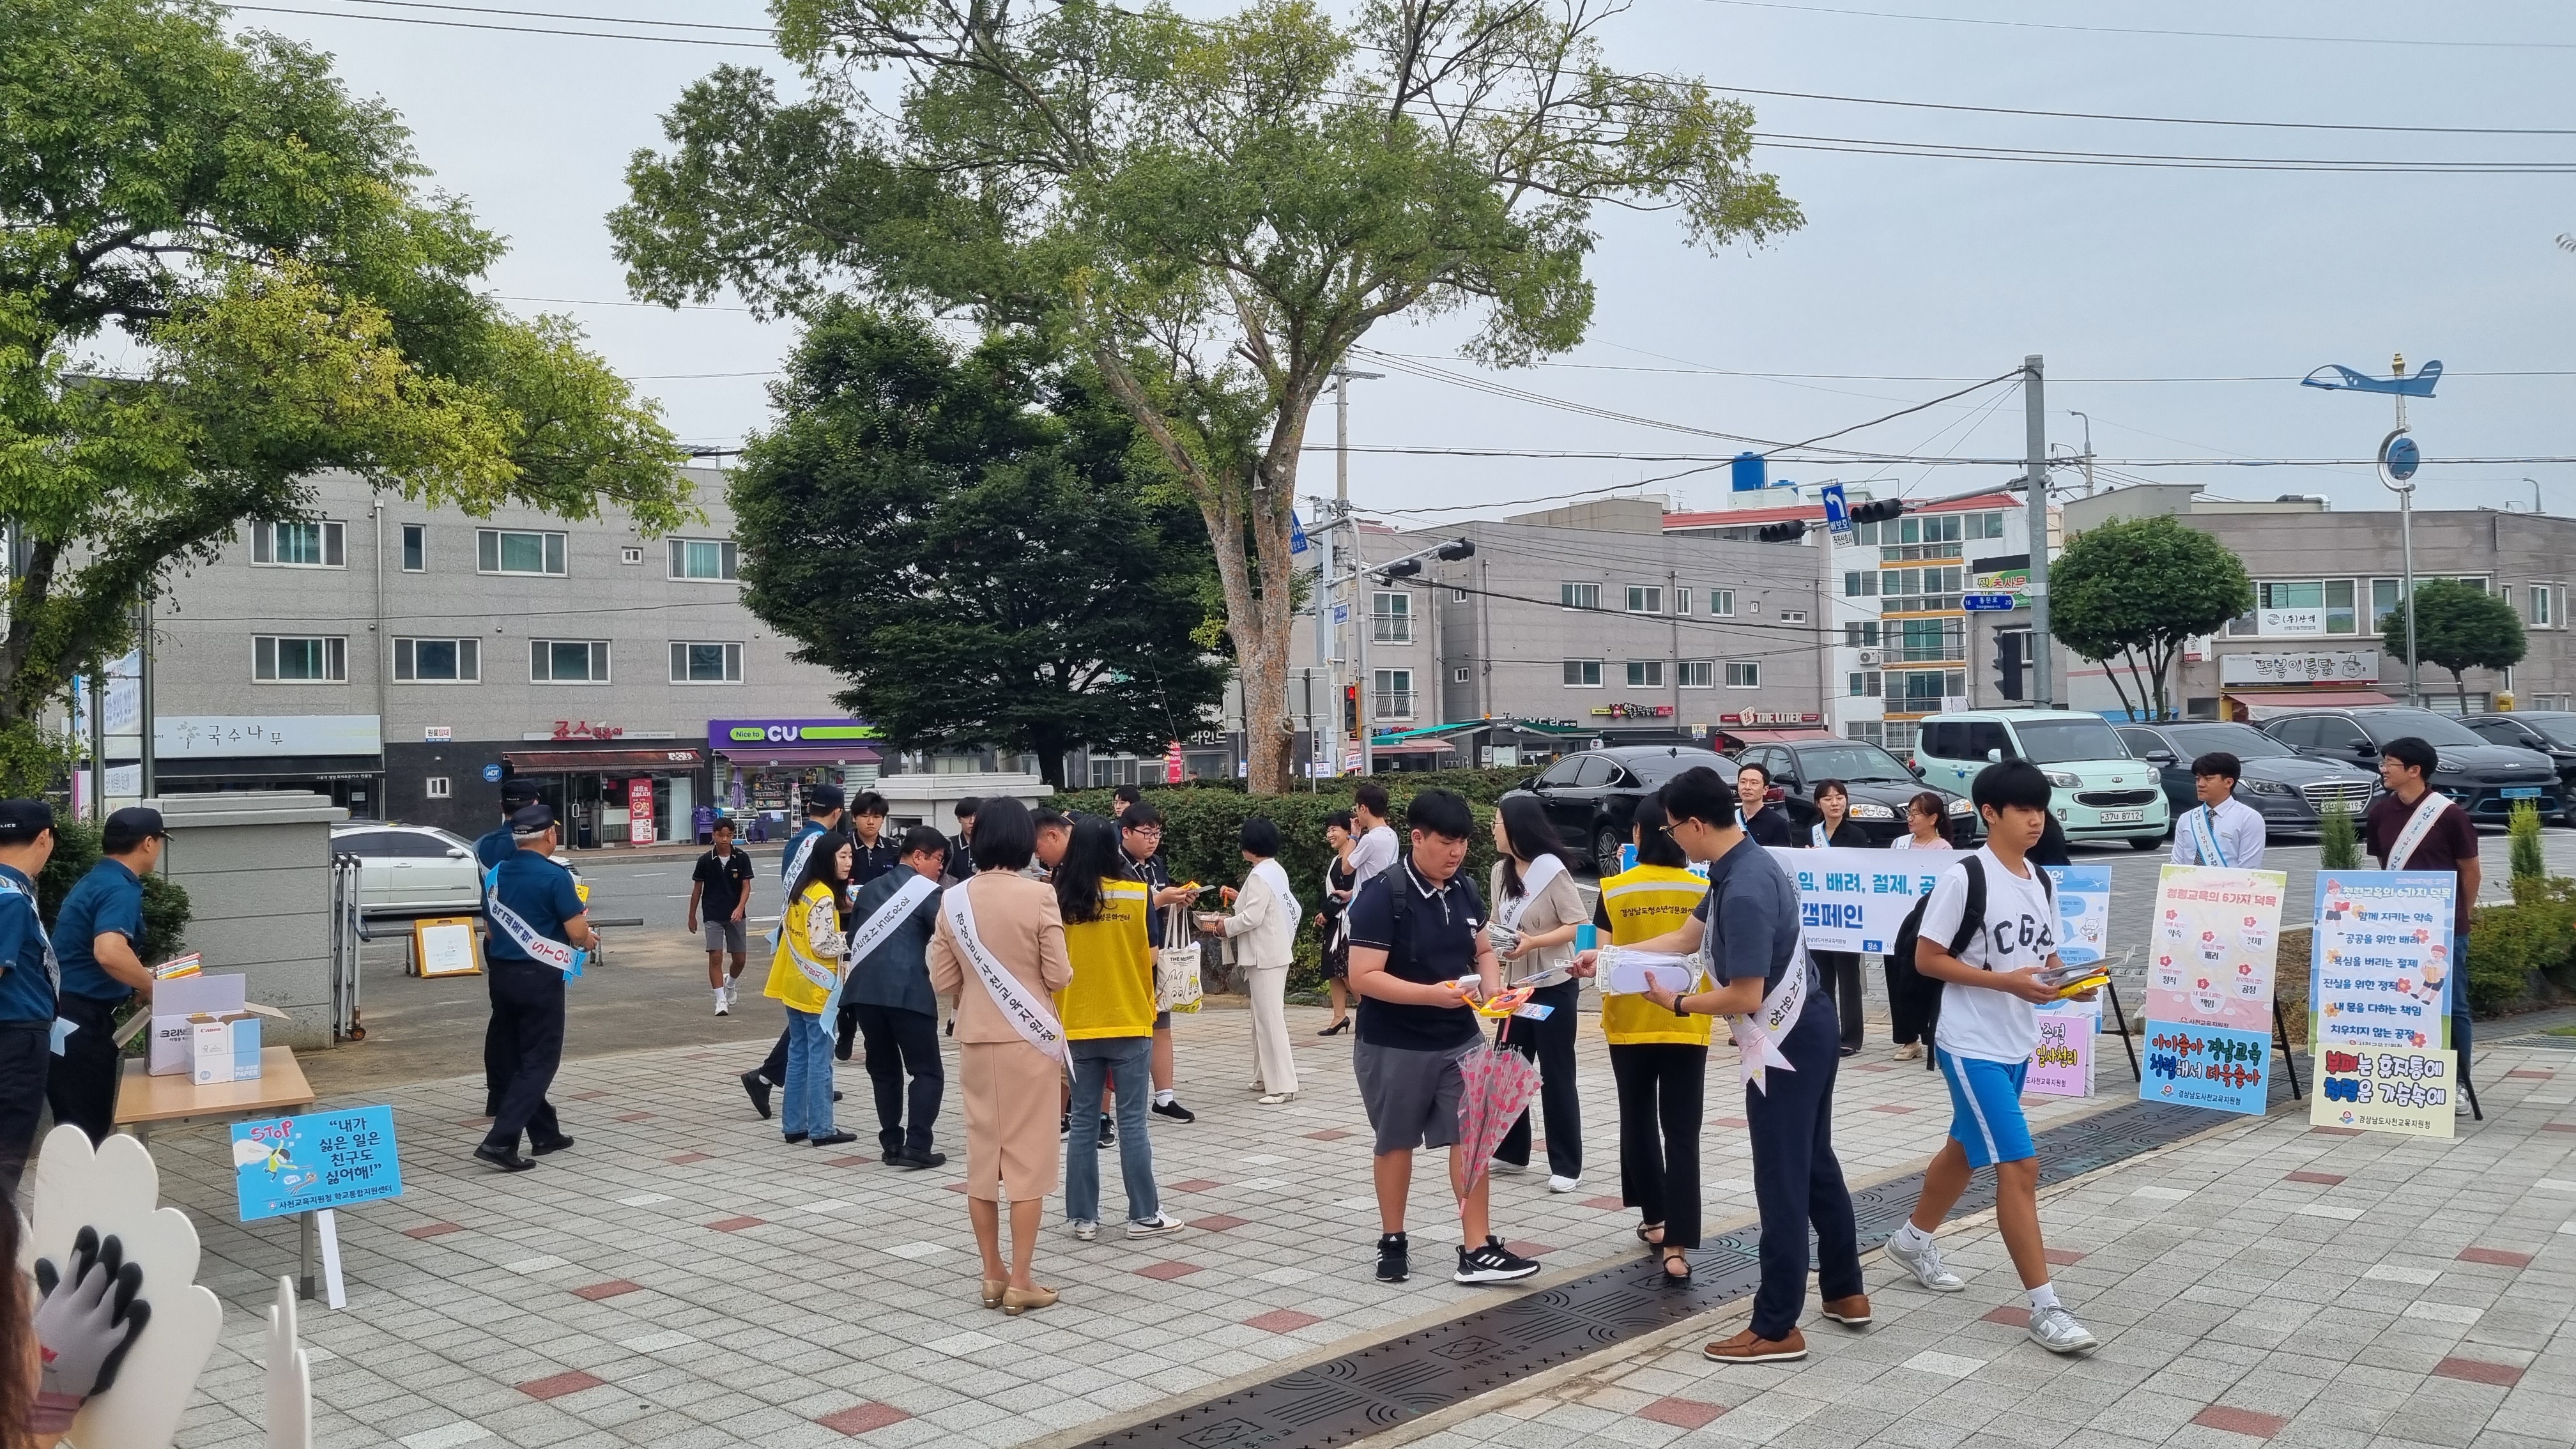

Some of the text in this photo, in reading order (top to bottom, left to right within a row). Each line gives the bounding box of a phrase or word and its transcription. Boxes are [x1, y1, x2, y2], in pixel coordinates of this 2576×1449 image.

[1830, 519, 1849, 530] 비보호
[2255, 657, 2336, 680] 또봉이통닭
[1756, 712, 1775, 723] THE
[1775, 712, 1803, 723] LITER
[208, 724, 283, 746] 국수나무
[427, 728, 449, 737] 원룸임대
[767, 725, 798, 742] CU
[2121, 812, 2140, 820] 8712
[1797, 871, 1820, 892] 임,
[1825, 872, 1866, 894] 배려,
[1872, 873, 1912, 896] 절제,
[1919, 875, 1936, 896] 공
[2342, 885, 2395, 899] 청렴교육의
[2397, 887, 2428, 899] 6가지
[2166, 887, 2277, 907] 청렴교육의 6가지 덕목
[1802, 902, 1864, 930] 캠페인
[2358, 912, 2434, 923] 함께 지키는 약속
[1866, 942, 1878, 951] 장소
[2345, 933, 2419, 945] 공공을 위한 배려
[2334, 956, 2418, 969] 욕심을 버리는 절제
[2162, 976, 2177, 985] 정직
[2322, 978, 2399, 992] 진실을 위한 정직
[2333, 1002, 2421, 1016] 내 몫을 다하는 책임
[2040, 1022, 2066, 1045] 주면
[2330, 1023, 2415, 1041] 치우치지 않는 공정
[2035, 1043, 2078, 1069] 일사천리
[2151, 1032, 2262, 1066] 아이좋아 경남교육
[2149, 1052, 2262, 1089] 청렴해서 더욱좋아
[2326, 1050, 2444, 1081] 부패는 휴지통에
[2025, 1077, 2066, 1088] 도사천교육지원청
[2178, 1090, 2241, 1106] 경상남도사천교육지원청
[2324, 1076, 2446, 1108] 청렴은 가슴속에
[250, 1119, 293, 1142] STOP
[329, 1117, 367, 1133] “내가
[2359, 1115, 2431, 1130] 경상남도사천교육지원청
[319, 1131, 382, 1153] 싫은 일은
[330, 1149, 375, 1167] 친구도
[325, 1163, 382, 1186] 싫어해!”
[279, 1184, 392, 1209] 사천교육지원청 학교통합지원센터
